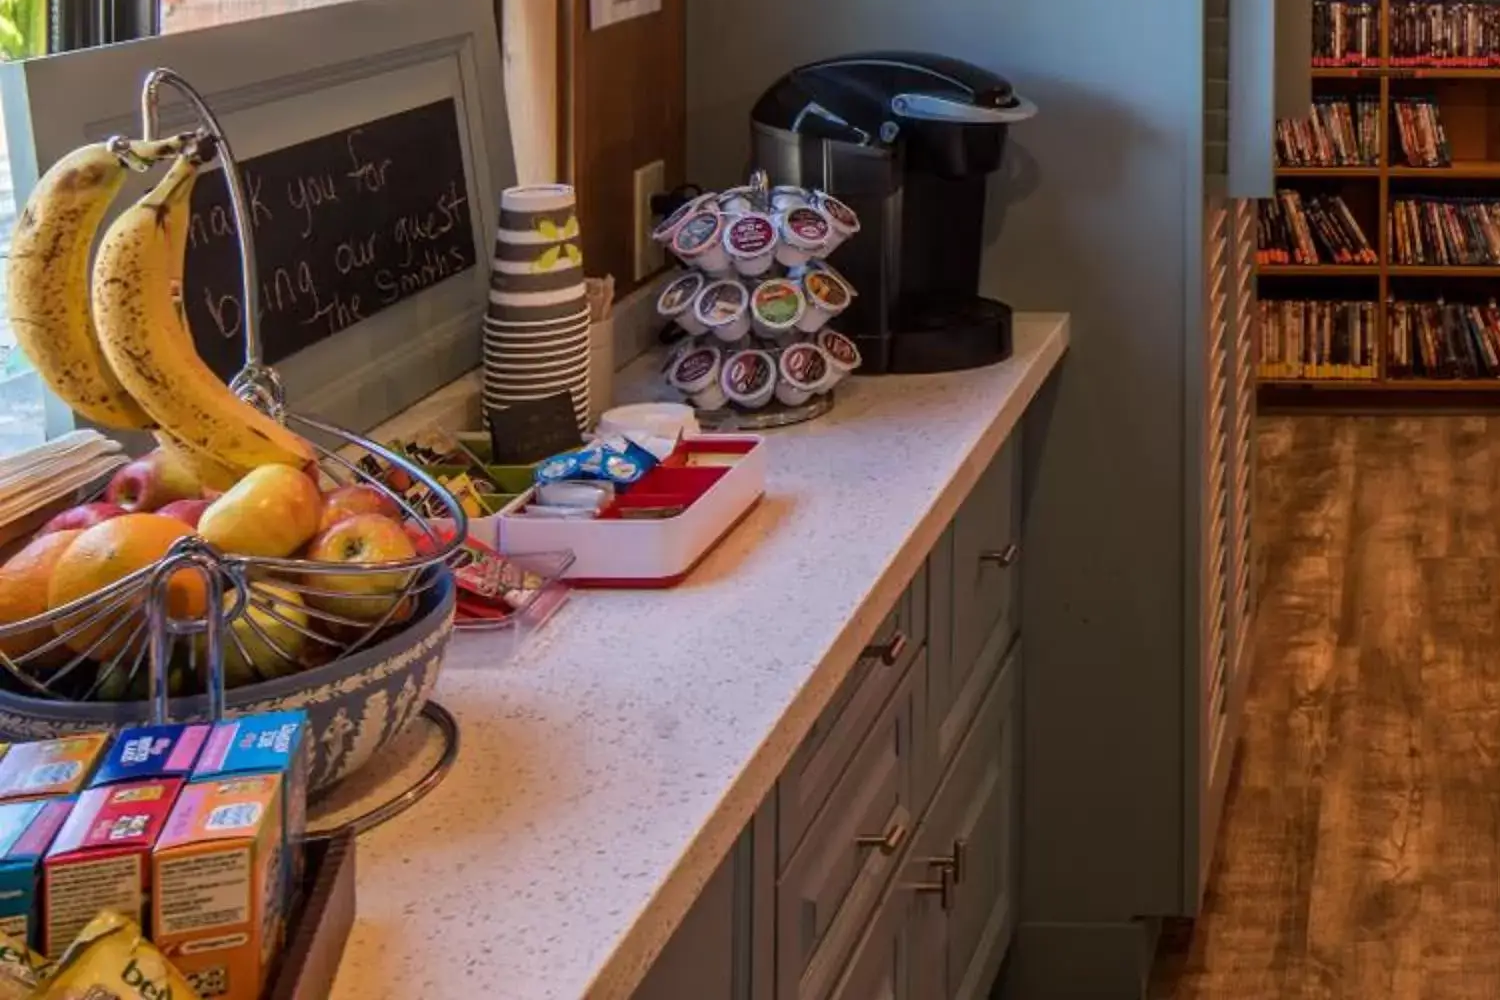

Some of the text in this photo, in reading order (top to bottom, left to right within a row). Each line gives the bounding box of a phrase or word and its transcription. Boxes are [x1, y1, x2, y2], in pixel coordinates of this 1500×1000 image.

[287, 171, 337, 239] you
[347, 129, 393, 193] for
[203, 179, 467, 340] bing our guest
